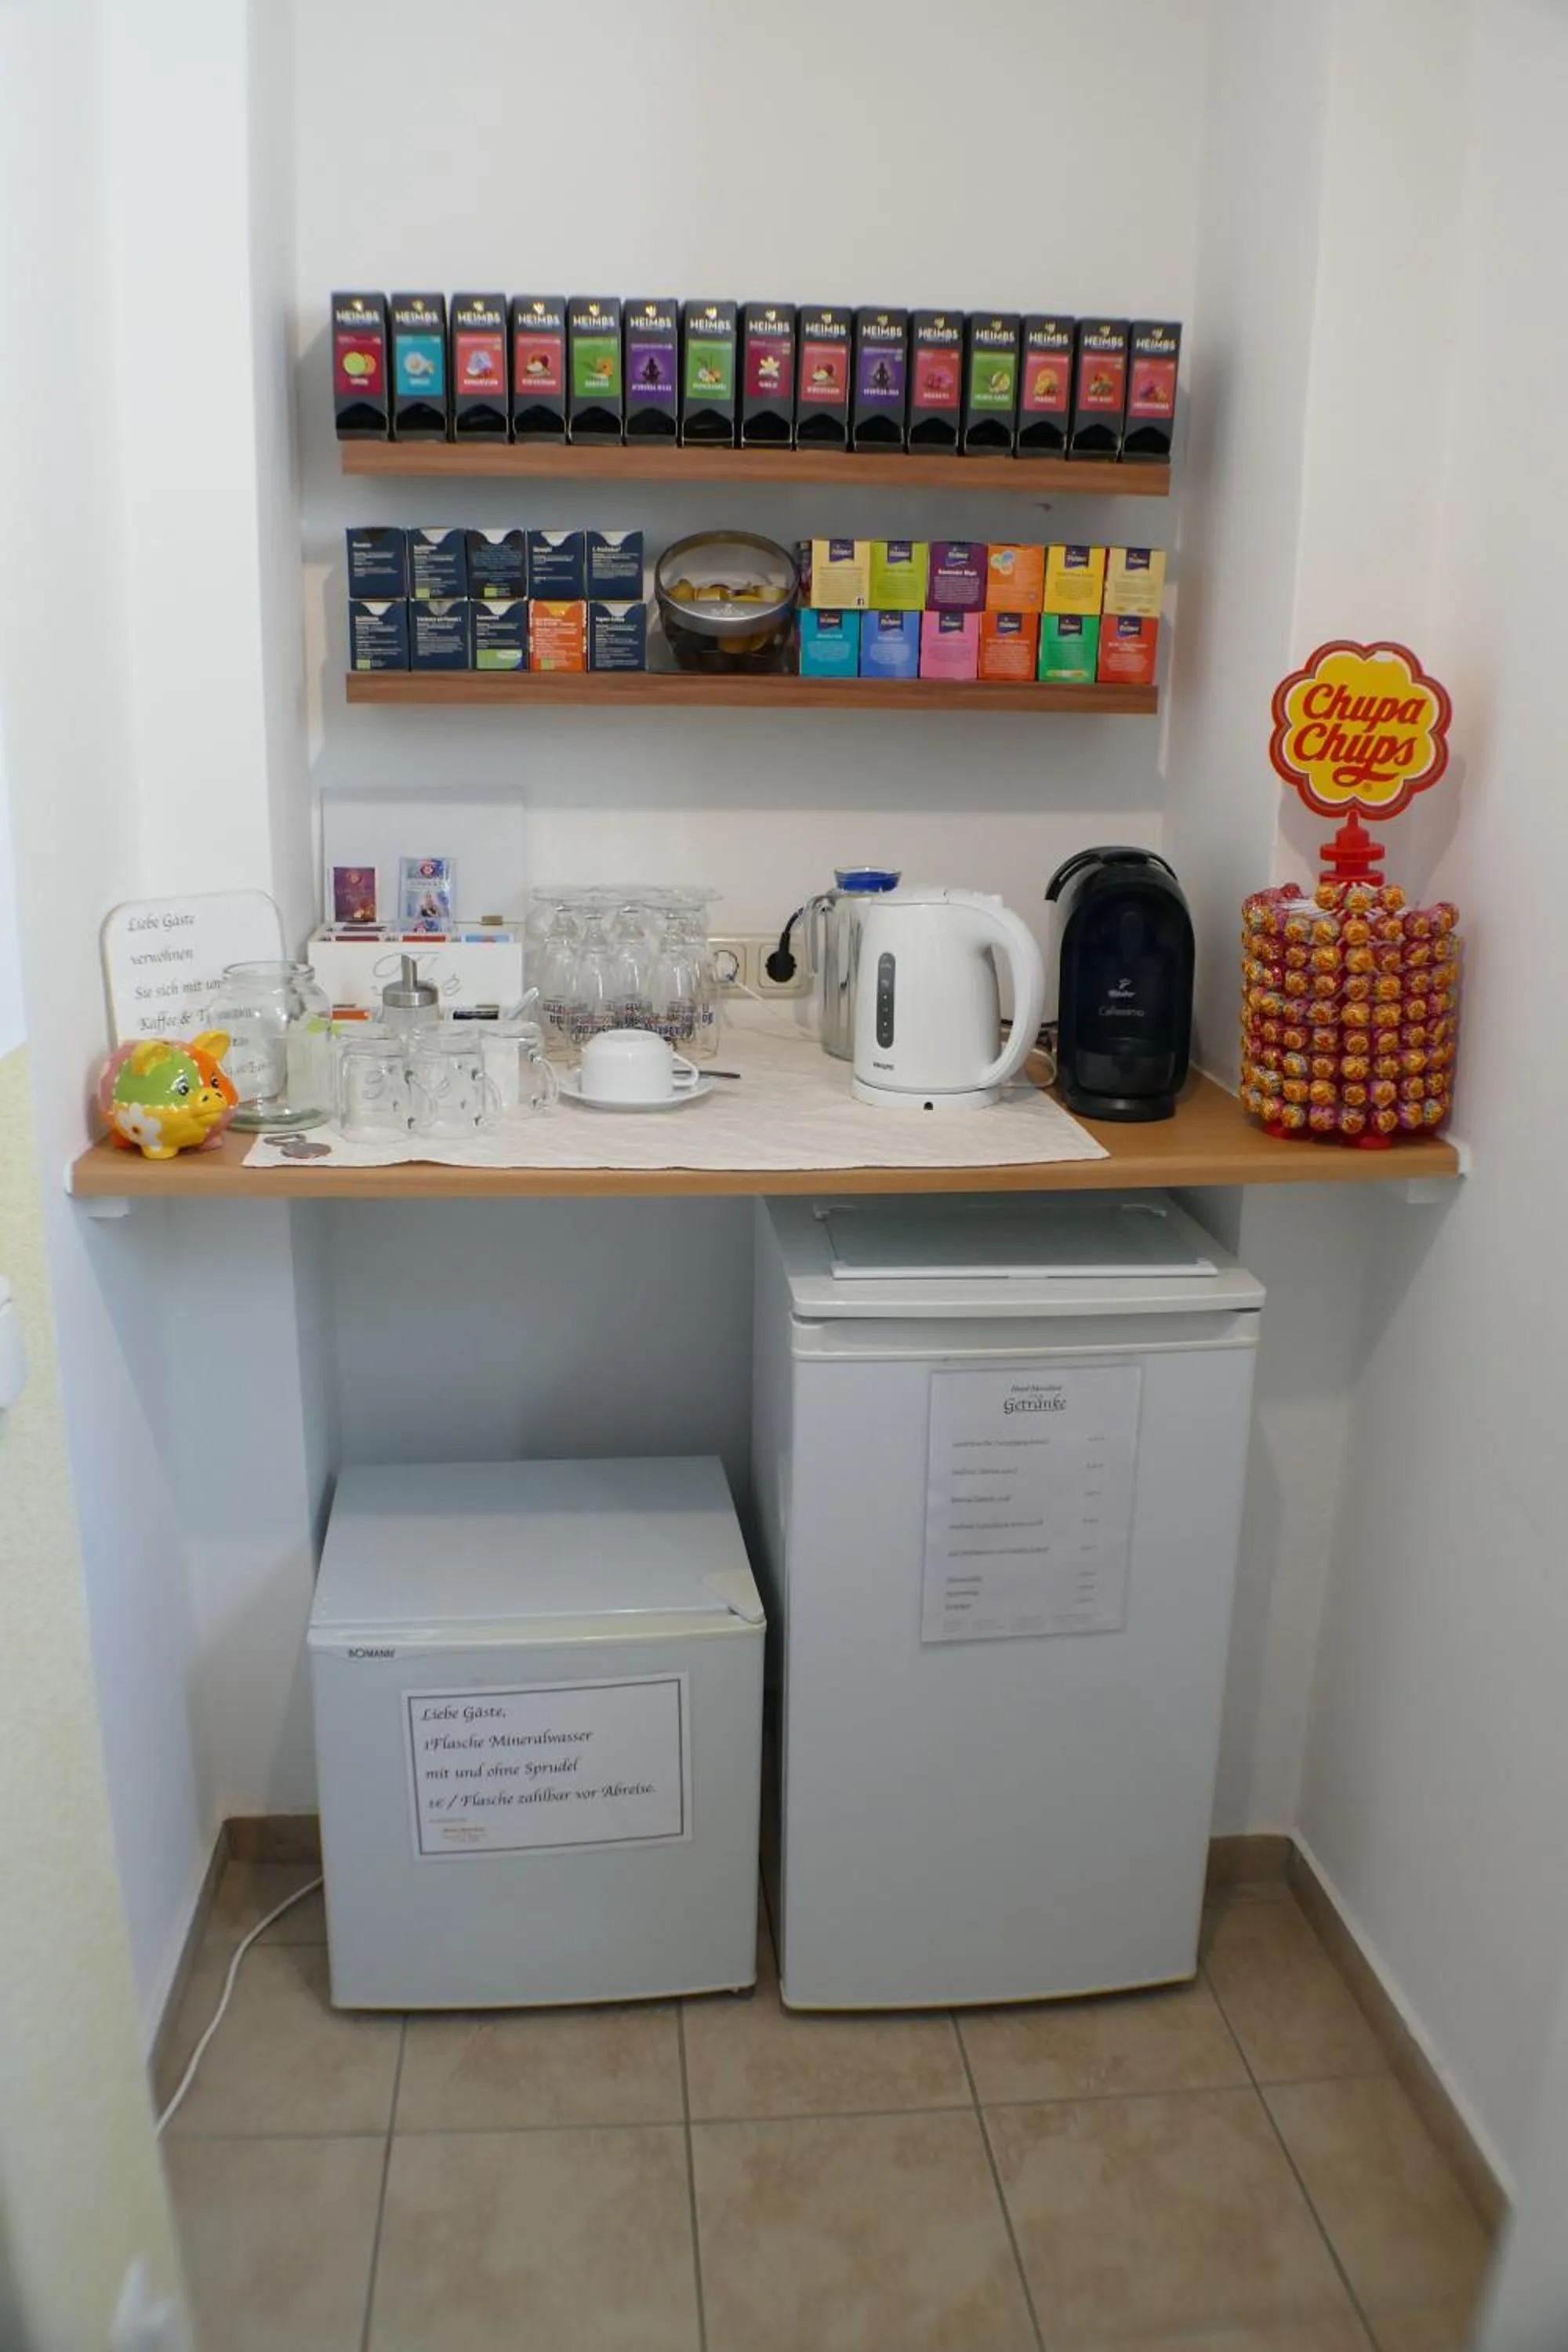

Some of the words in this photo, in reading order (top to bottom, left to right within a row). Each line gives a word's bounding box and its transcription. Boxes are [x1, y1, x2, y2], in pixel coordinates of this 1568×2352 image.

[1302, 683, 1428, 733] Chupa
[1294, 723, 1417, 787] Chups
[127, 912, 158, 931] Liebe
[421, 1705, 459, 1721] Liebe
[488, 1729, 593, 1747] Mineralwasser
[426, 1769, 448, 1780] mit
[456, 1762, 485, 1778] und
[487, 1762, 519, 1777] ohne
[524, 1756, 580, 1780] Sprudel
[460, 1791, 514, 1807] Flasche
[517, 1787, 571, 1803] zahlbar
[575, 1790, 598, 1800] vor
